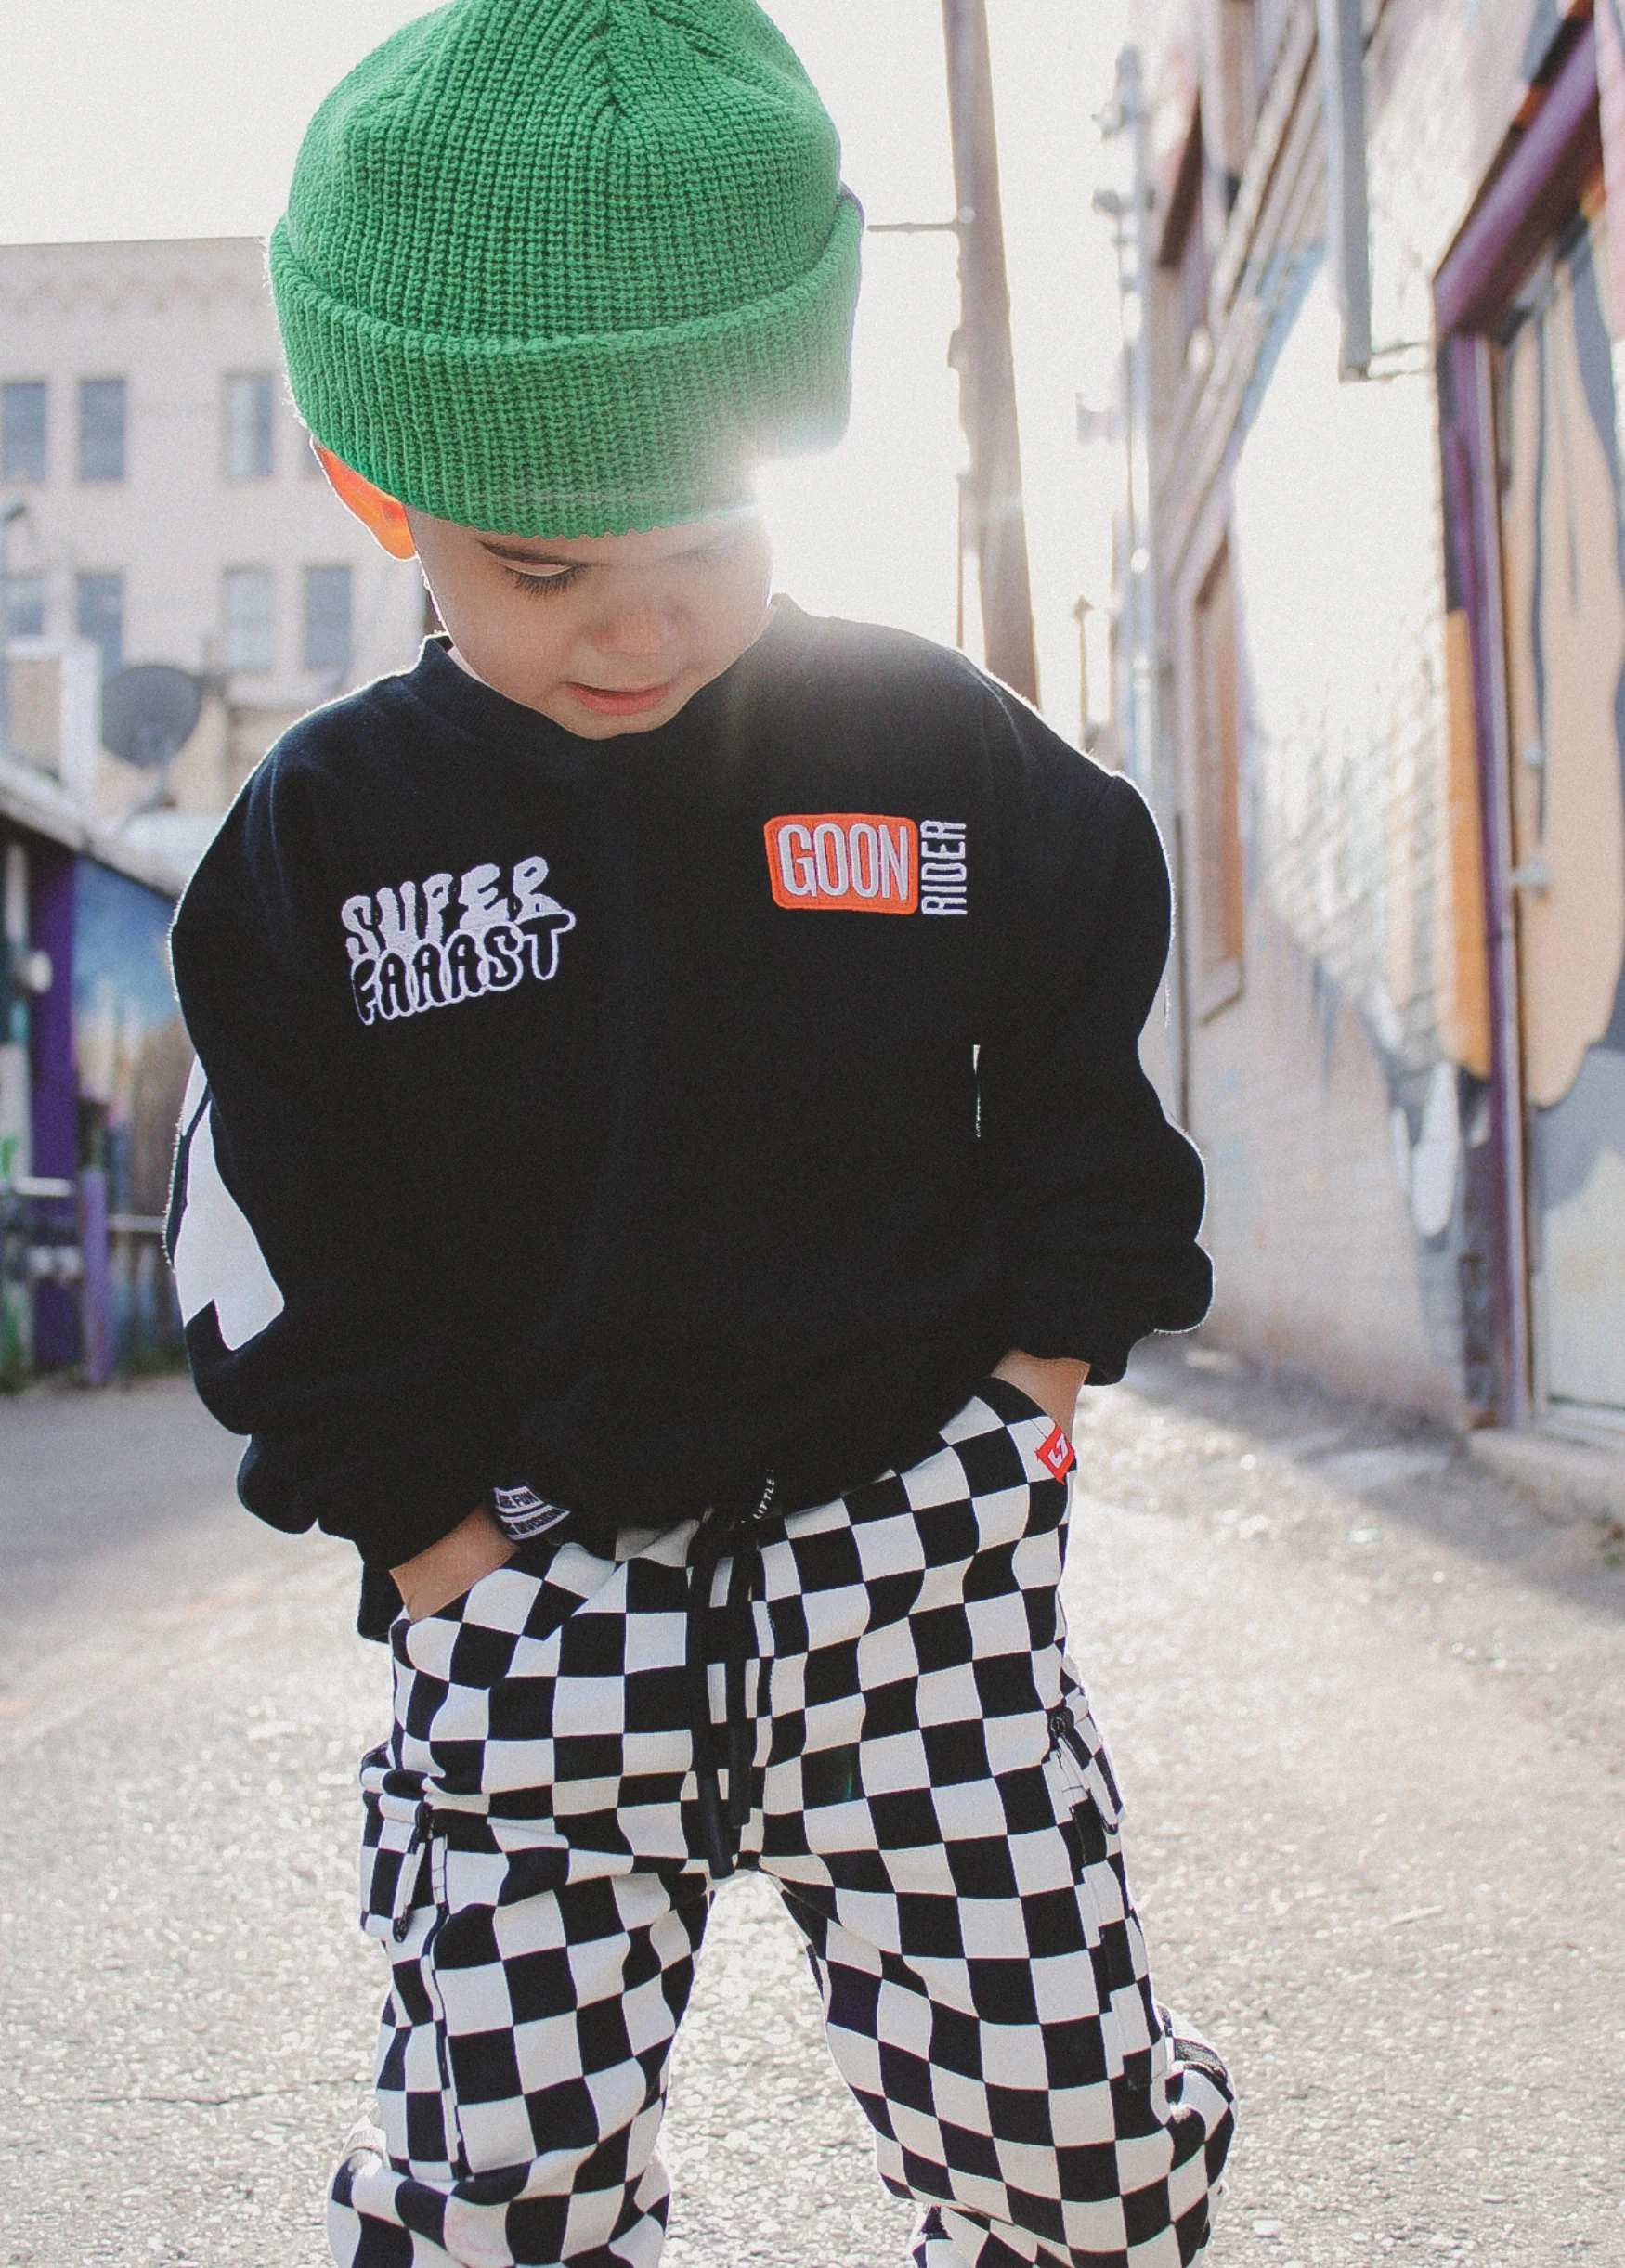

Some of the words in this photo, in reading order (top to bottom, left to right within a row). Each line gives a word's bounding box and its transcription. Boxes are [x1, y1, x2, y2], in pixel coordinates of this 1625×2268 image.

[341, 856, 563, 960] SUPER
[778, 823, 909, 902] GOON
[919, 819, 968, 916] RIDER
[350, 908, 576, 1026] FAAAST
[752, 1477, 775, 1520] LITTLE
